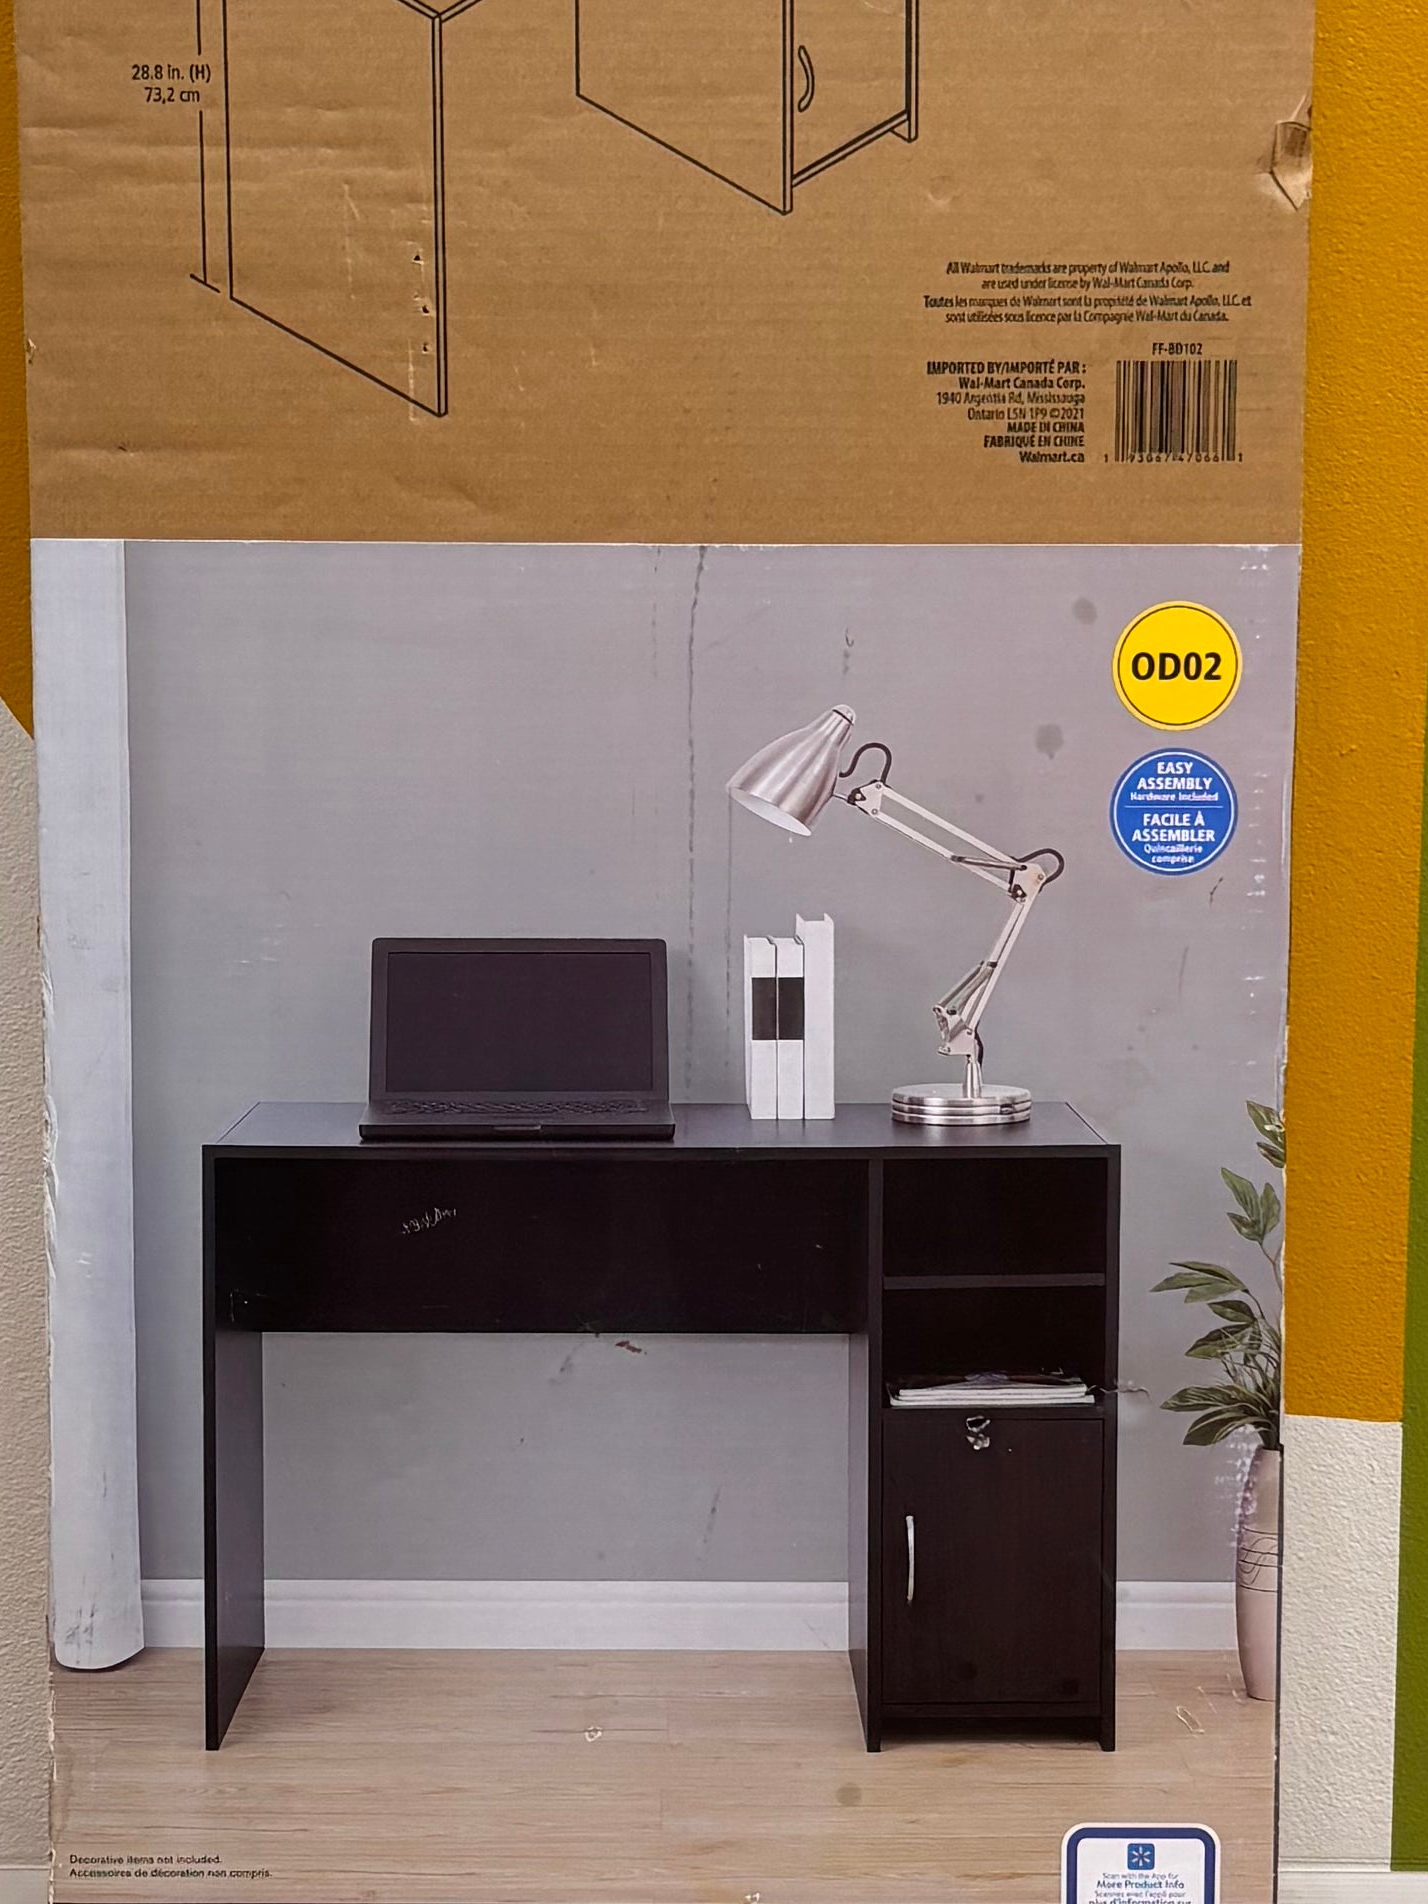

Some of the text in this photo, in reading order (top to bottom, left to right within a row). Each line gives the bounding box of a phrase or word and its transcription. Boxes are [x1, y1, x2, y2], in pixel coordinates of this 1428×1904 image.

[132, 64, 211, 83] 28.8 in. (H)
[144, 87, 200, 104] 73,2 cm
[927, 362, 984, 375] IMPORTED
[1058, 362, 1079, 374] PAR
[1013, 377, 1053, 389] Canada
[1057, 377, 1085, 391] Corp.
[968, 408, 1004, 420] Ontario
[1007, 422, 1036, 433] MADE
[1019, 451, 1084, 463] Walmart.ca
[1132, 652, 1222, 680] OD02
[1157, 762, 1192, 774] EASY
[1137, 778, 1212, 789] ASSEMBLY
[1143, 811, 1205, 826] FACILE À
[1132, 829, 1215, 841] ASSEMBLER
[70, 1855, 123, 1864] Decorative
[127, 1855, 154, 1864] items
[177, 1855, 221, 1864] included.
[69, 1868, 131, 1877] Accessoires
[135, 1868, 147, 1877] de
[151, 1868, 204, 1877] décoration
[230, 1869, 272, 1879] compris.
[1097, 1880, 1184, 1888] More Product Info
